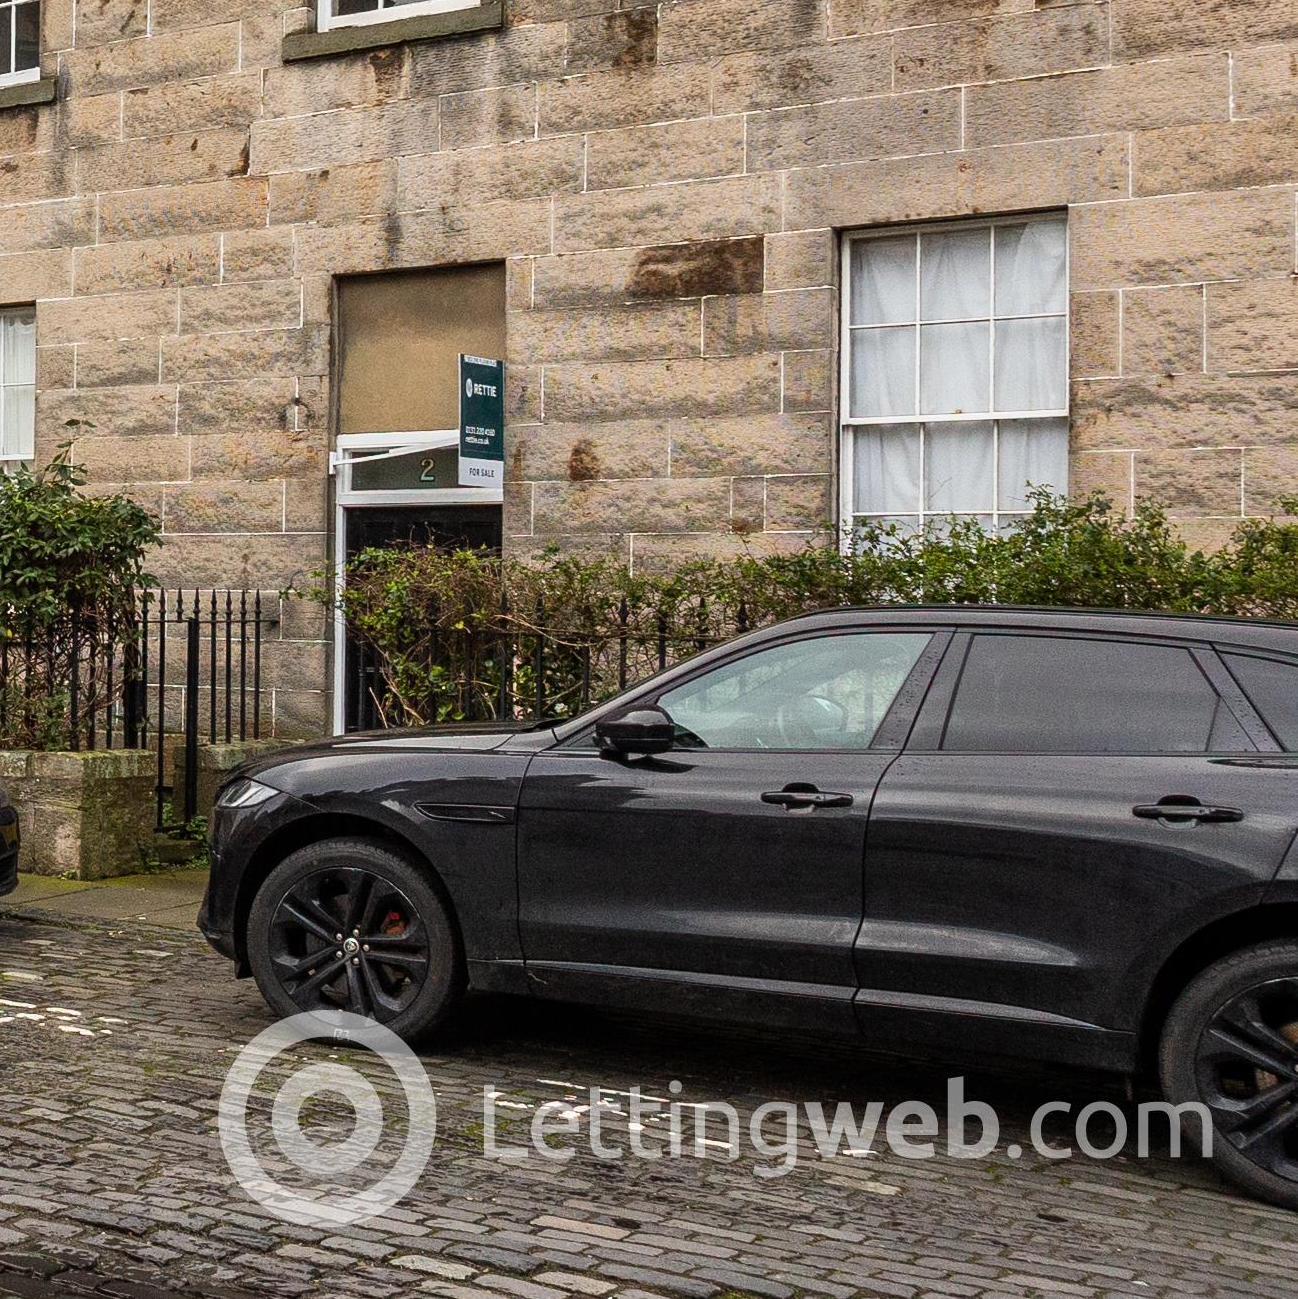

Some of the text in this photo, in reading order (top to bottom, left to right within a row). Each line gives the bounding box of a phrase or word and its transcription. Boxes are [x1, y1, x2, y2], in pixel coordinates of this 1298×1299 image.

[474, 383, 497, 397] RETTIE
[420, 458, 435, 481] 2
[469, 467, 495, 478] FOR SALE
